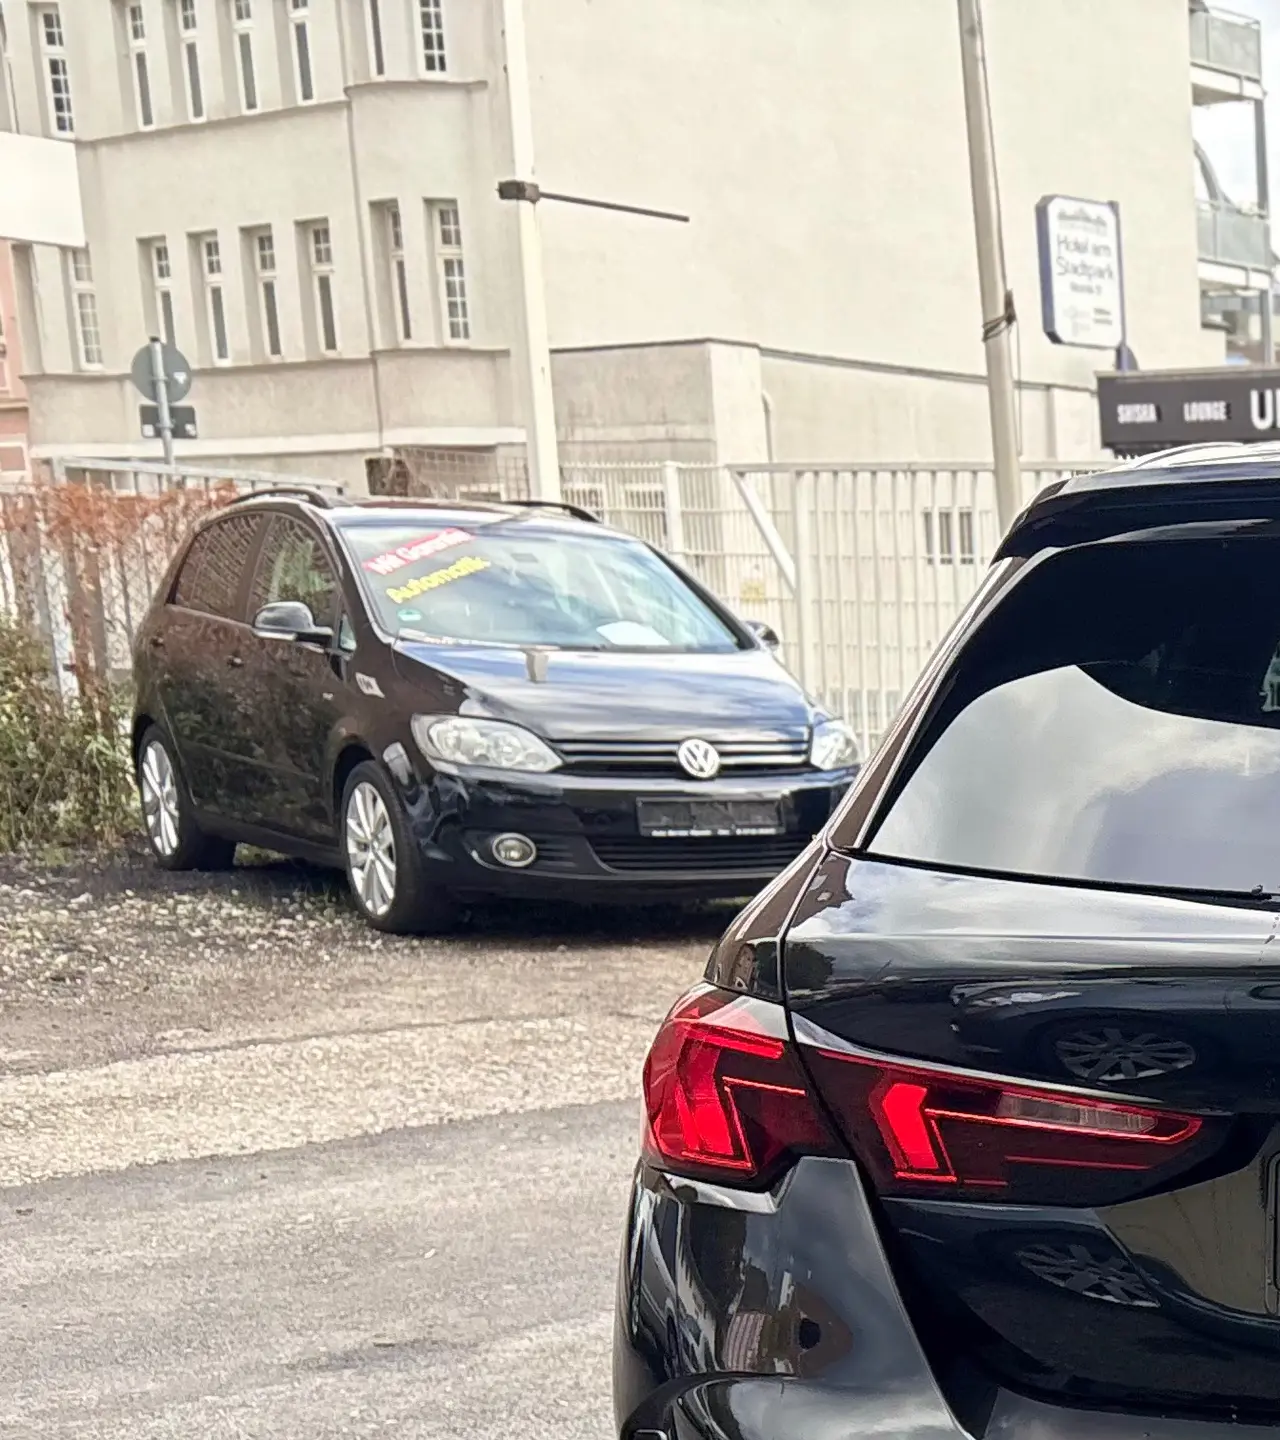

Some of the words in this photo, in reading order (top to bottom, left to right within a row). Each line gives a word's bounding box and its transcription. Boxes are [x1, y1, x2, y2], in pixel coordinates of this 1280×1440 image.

[1116, 403, 1157, 424] SHISHA
[1184, 400, 1227, 422] LOUNGE
[386, 556, 492, 604] Automatik
